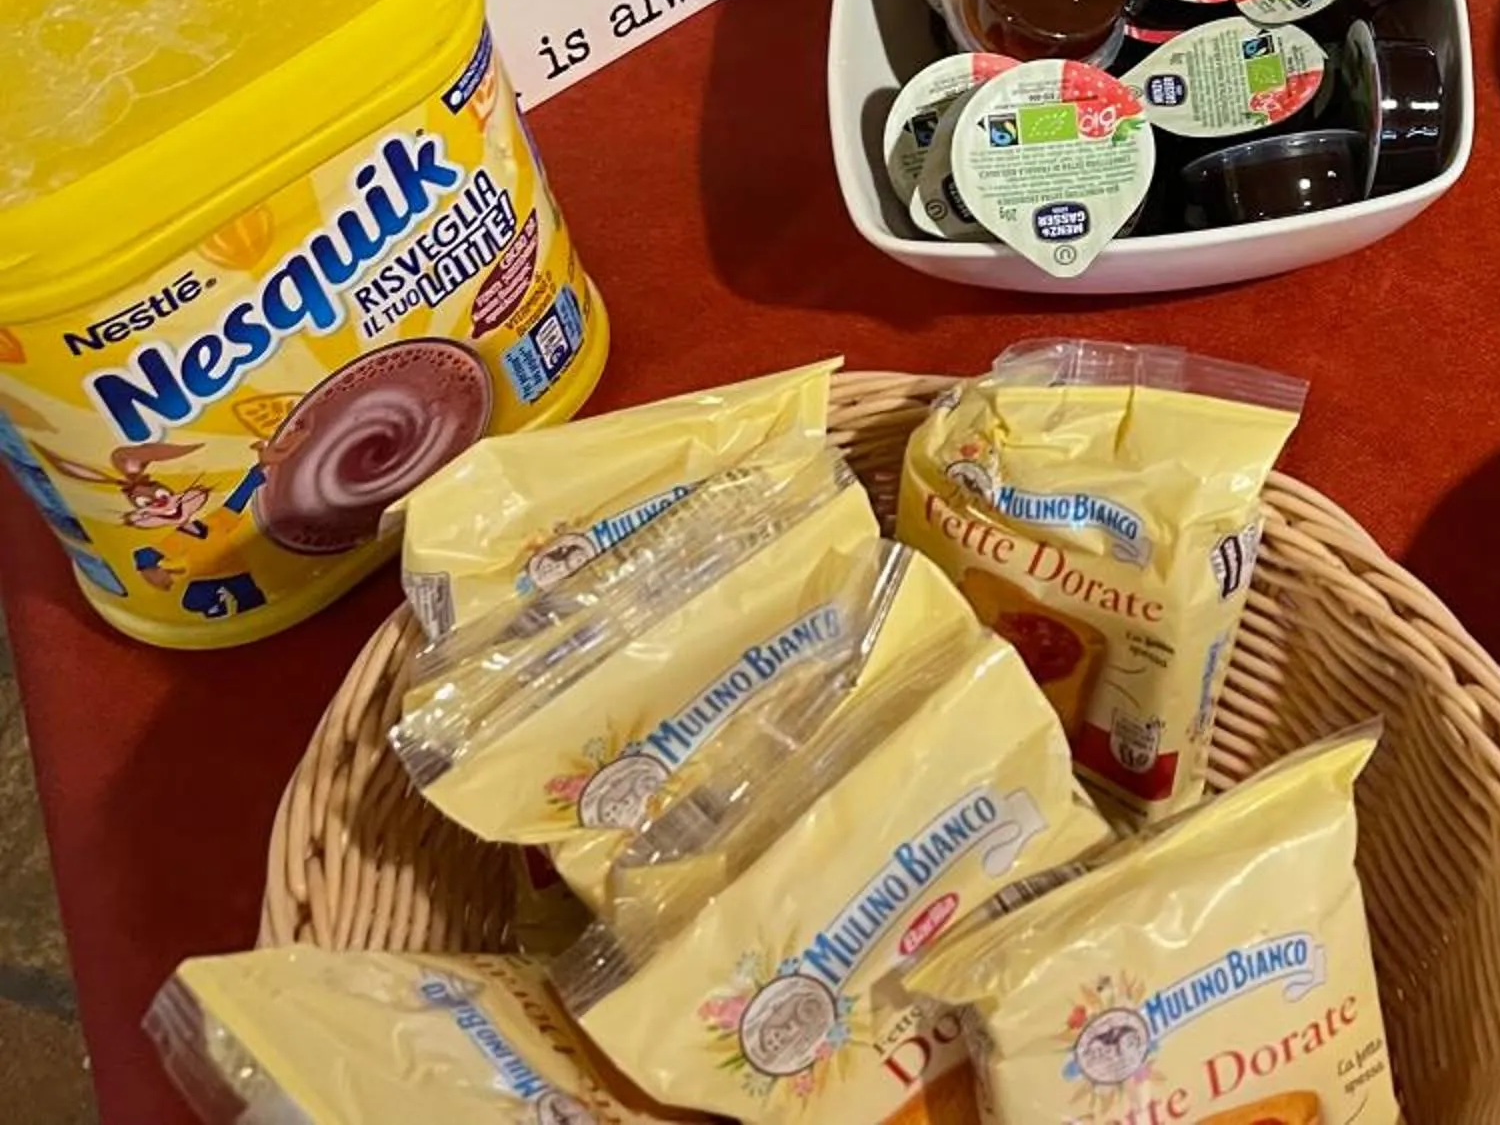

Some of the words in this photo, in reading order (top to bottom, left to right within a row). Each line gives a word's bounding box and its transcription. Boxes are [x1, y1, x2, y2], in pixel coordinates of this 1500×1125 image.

[538, 29, 590, 80] is
[354, 169, 497, 314] RISVEGLIA
[363, 311, 387, 339] IL
[382, 288, 420, 326] TUO
[417, 190, 517, 308] LATTE!
[1037, 210, 1085, 225] GASSER
[93, 136, 457, 443] Nesquik
[994, 485, 1073, 523] MULINO
[1071, 495, 1140, 540] BIANCO
[1025, 540, 1164, 624] Dorate
[647, 658, 754, 765] MULINO
[803, 873, 921, 984] MULINO
[895, 793, 998, 885] BIANCO
[1147, 955, 1229, 1035] MULINO
[1226, 936, 1309, 998] BIANCO
[1203, 995, 1358, 1100] Dorate
